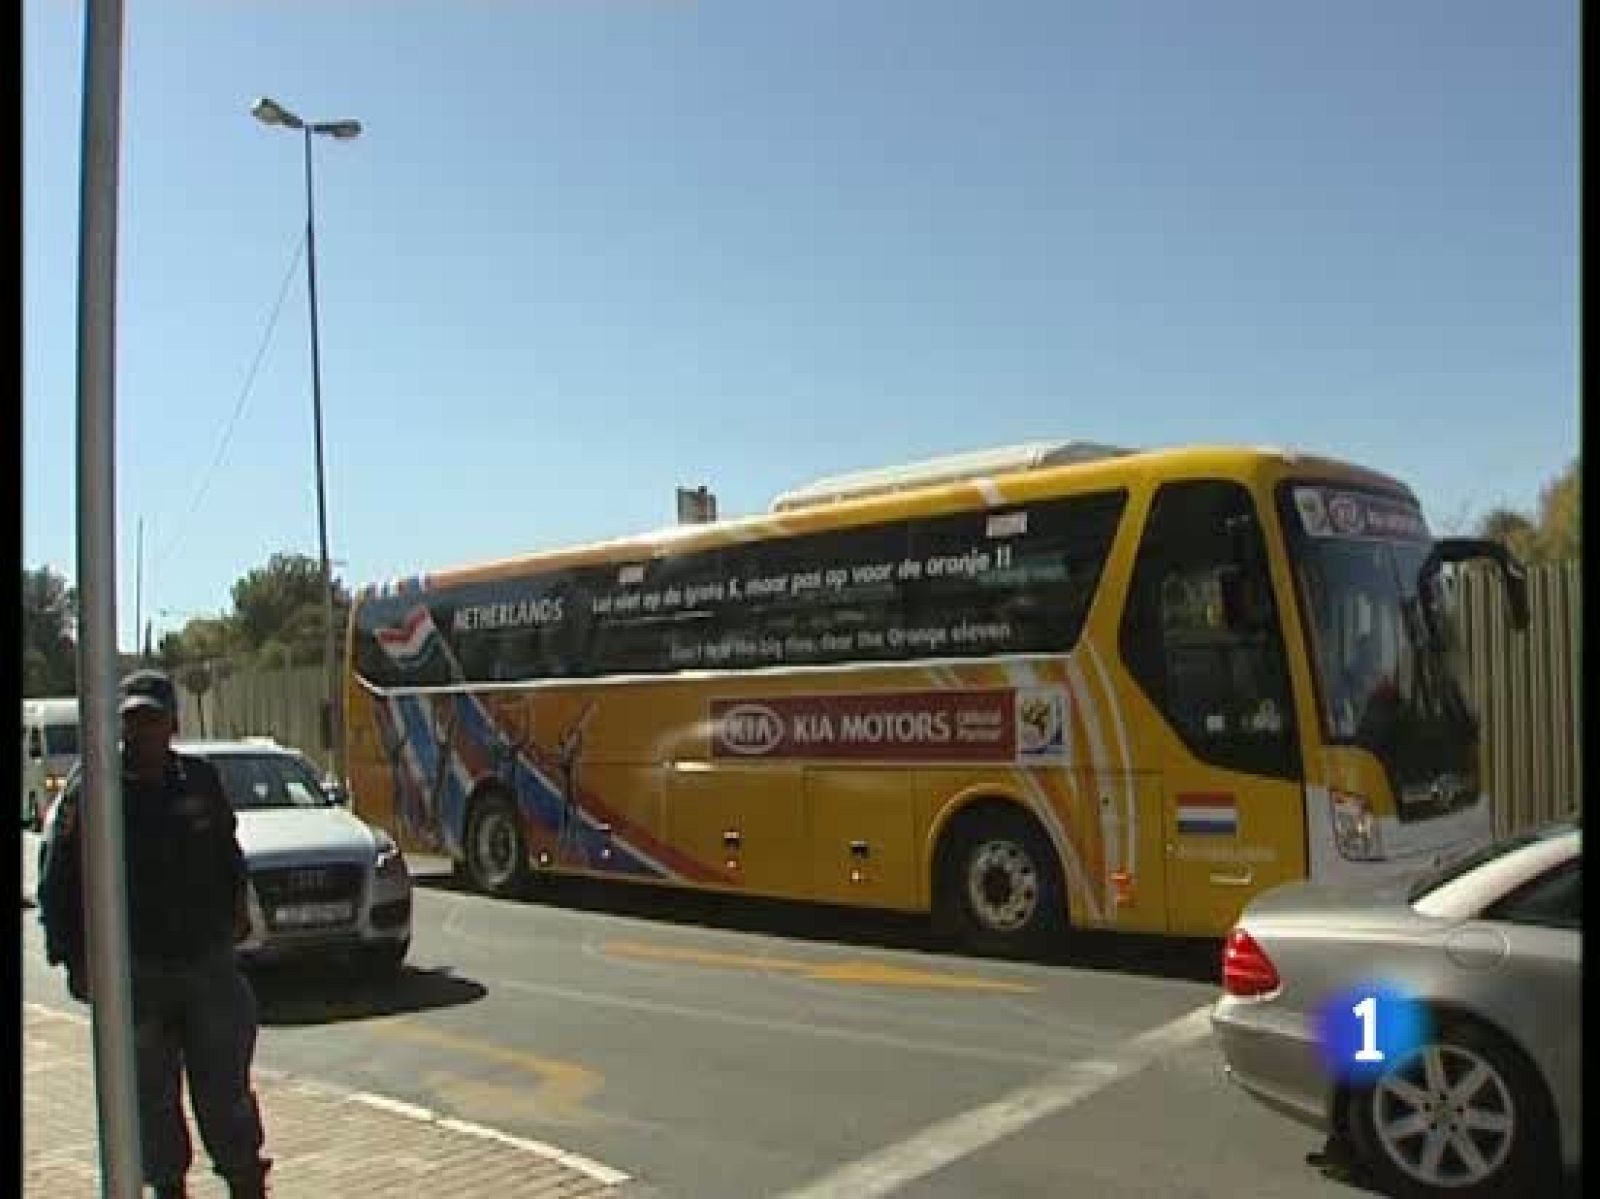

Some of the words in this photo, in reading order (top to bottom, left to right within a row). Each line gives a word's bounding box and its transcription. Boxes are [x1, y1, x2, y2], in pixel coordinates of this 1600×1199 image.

[852, 562, 893, 583] voor
[899, 558, 921, 580] de
[927, 547, 990, 577] oranje
[792, 711, 835, 744] KIA
[840, 709, 951, 744] MOTORS
